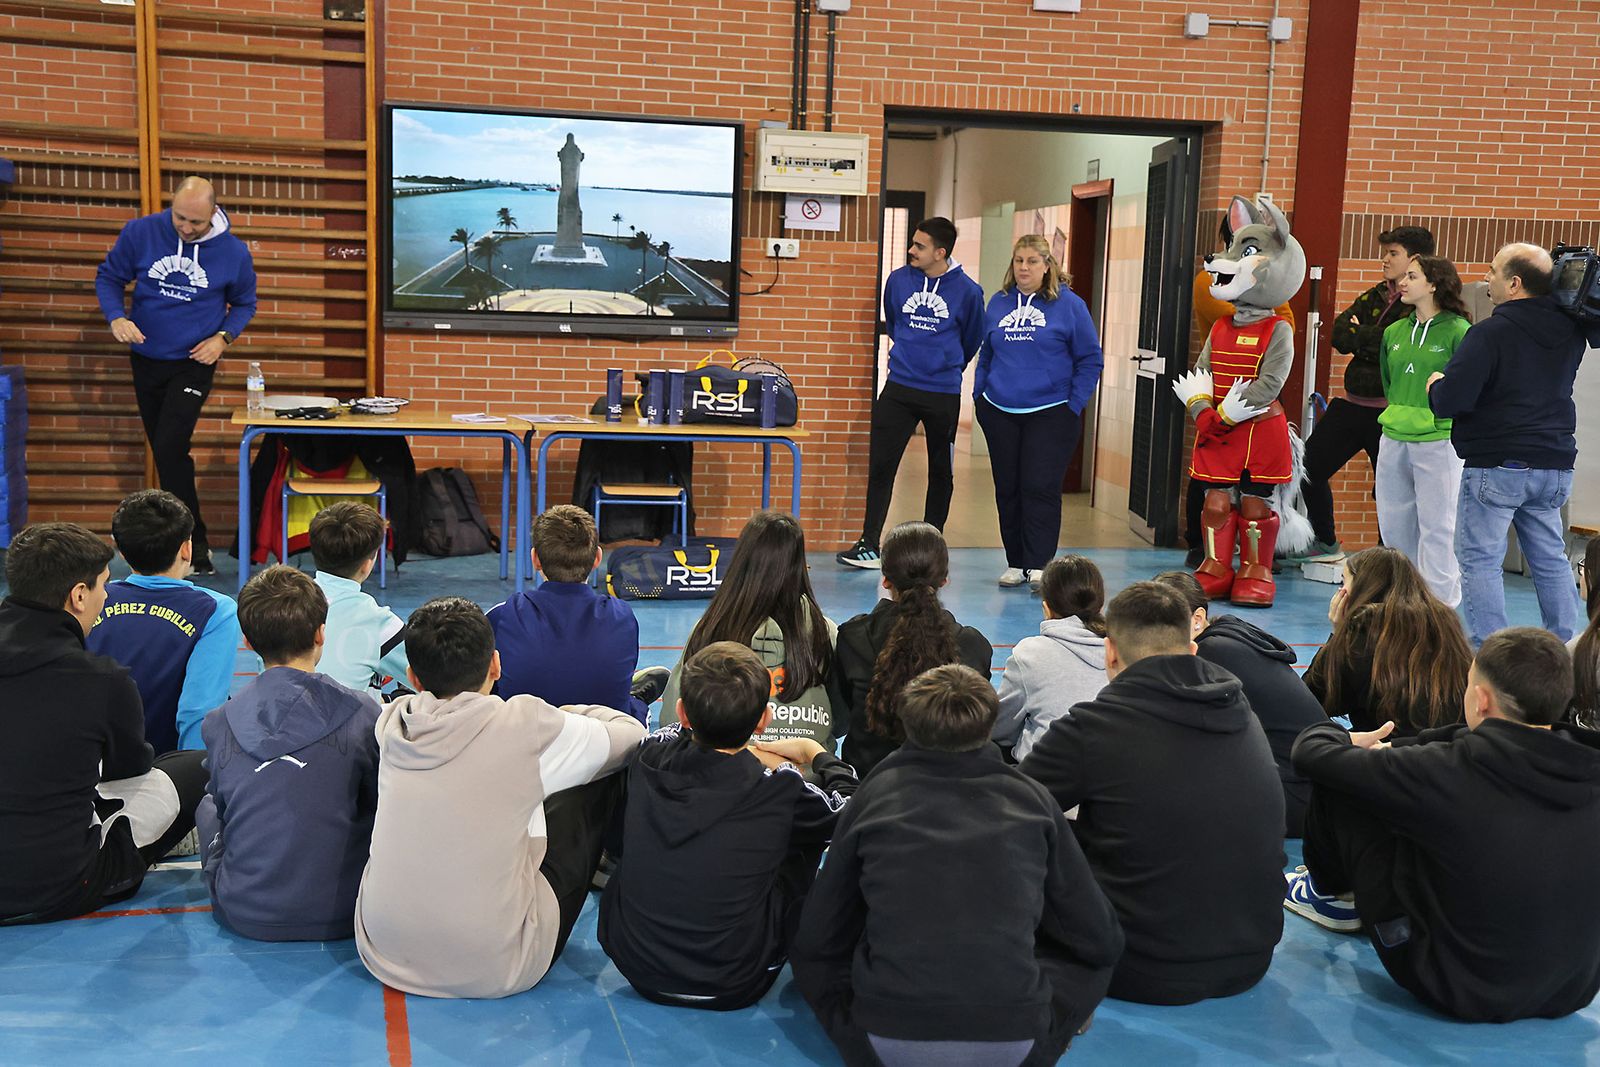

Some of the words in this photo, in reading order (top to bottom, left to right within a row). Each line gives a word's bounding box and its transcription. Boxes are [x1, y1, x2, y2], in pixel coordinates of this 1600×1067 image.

[692, 390, 755, 412] RSL
[666, 565, 723, 586] RSL
[105, 602, 146, 618] PÉREZ
[149, 604, 196, 637] CUBILLAS
[767, 701, 830, 726] Republic
[779, 727, 815, 735] COLLECTION
